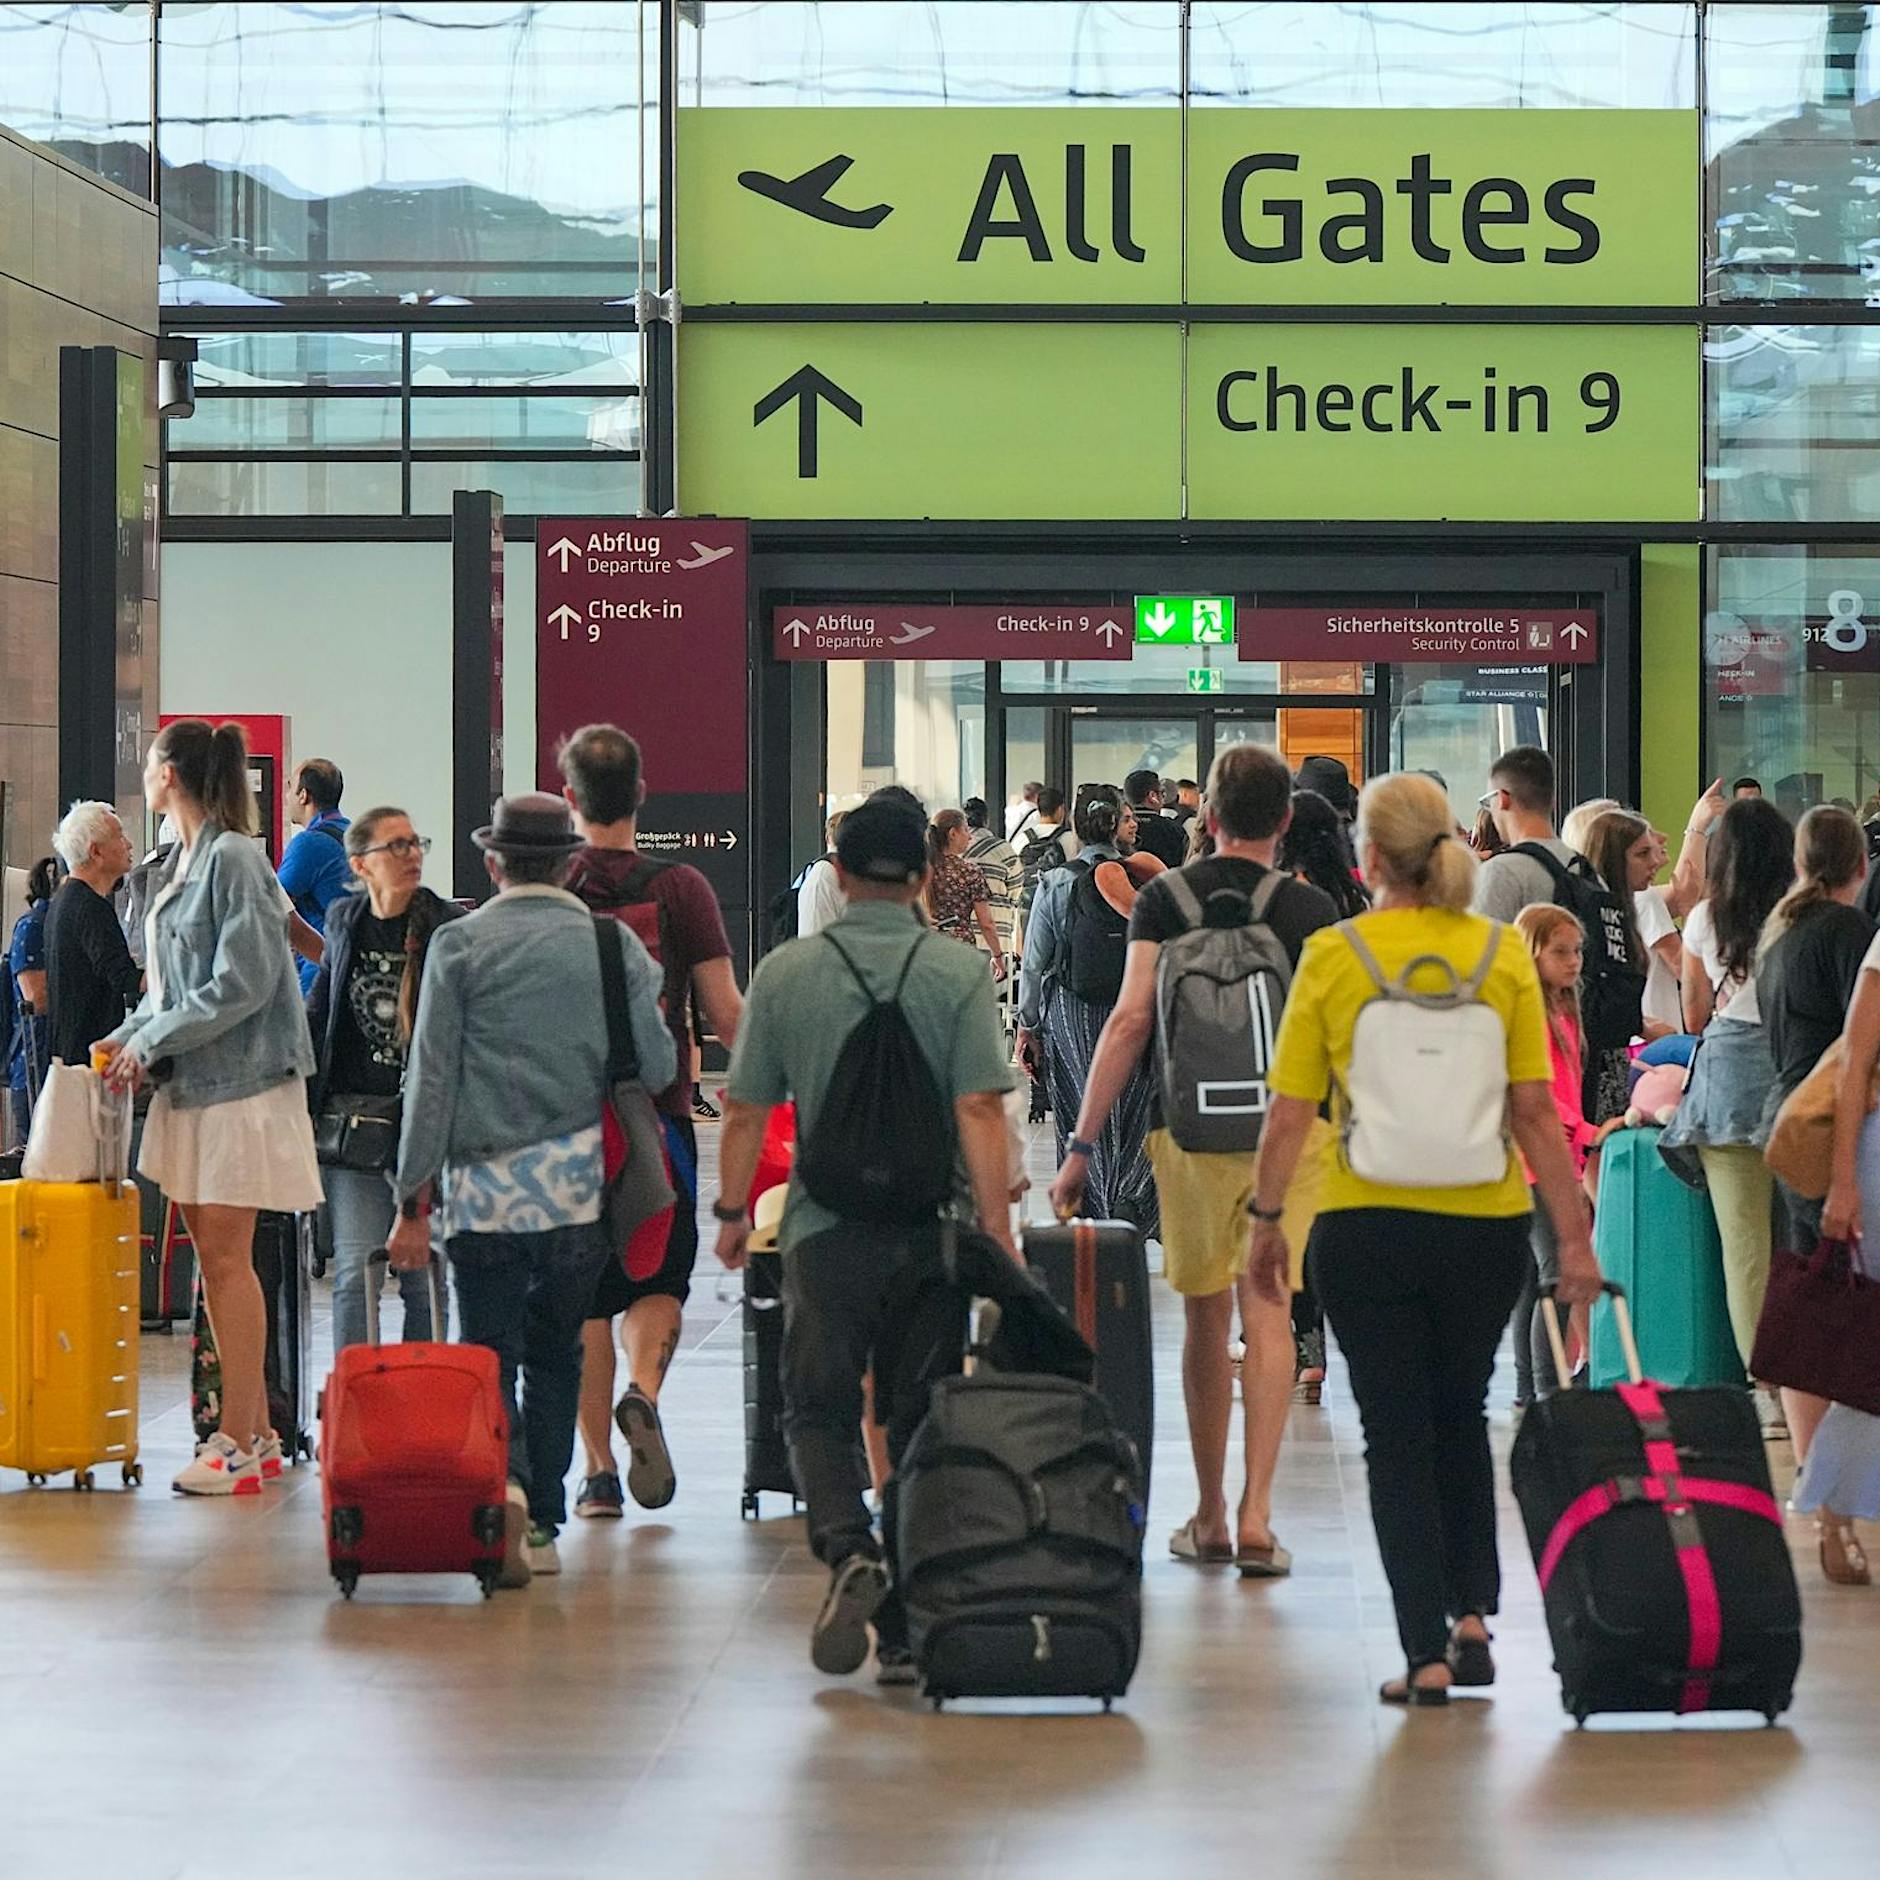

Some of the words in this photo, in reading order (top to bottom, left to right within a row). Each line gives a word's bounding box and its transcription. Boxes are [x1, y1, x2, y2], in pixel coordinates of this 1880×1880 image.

[957, 144, 1145, 263] All
[1222, 152, 1601, 264] Gates
[1216, 366, 1548, 433] Check-in
[1580, 371, 1620, 433] 9
[586, 533, 661, 556] Abflug
[587, 556, 671, 577] Departure
[588, 599, 682, 620] Check-in
[815, 615, 875, 635] Abflug
[997, 615, 1073, 632] Check-in
[1079, 617, 1089, 632] 9
[1327, 616, 1504, 634] Sicherheitskontrolle
[1510, 618, 1520, 634] 5
[1827, 590, 1867, 651] 8
[588, 624, 601, 643] 9
[816, 635, 884, 651] Departure
[1412, 636, 1467, 654] Security
[1471, 637, 1520, 652] Control
[1478, 667, 1519, 675] BUSINESS
[1488, 690, 1526, 698] ALLIANCE
